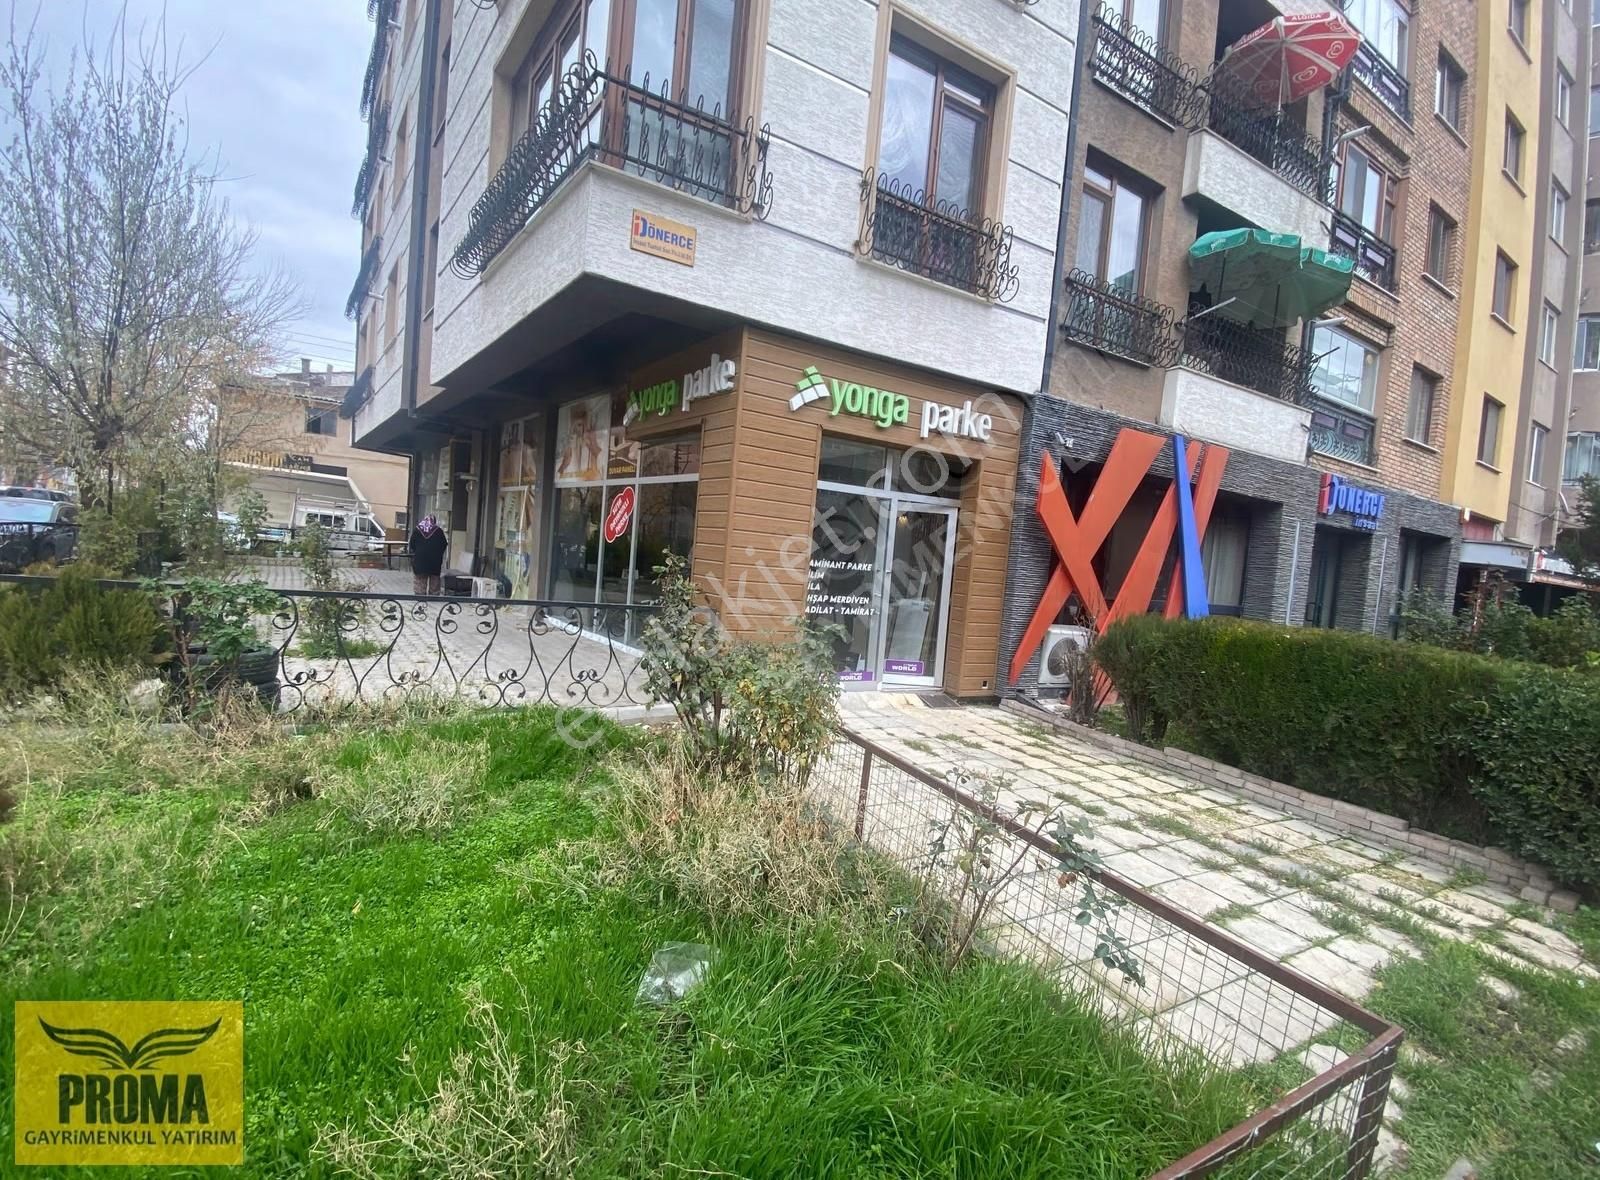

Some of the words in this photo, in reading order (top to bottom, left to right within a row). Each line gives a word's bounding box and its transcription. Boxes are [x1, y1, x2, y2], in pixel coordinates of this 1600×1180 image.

[638, 379, 677, 421] yonga
[681, 353, 736, 412] parke
[829, 378, 910, 428] yonga
[919, 399, 993, 441] parke
[847, 562, 873, 572] PARKE
[829, 594, 870, 605] MERDİVEN
[840, 604, 875, 616] TAMİRAT
